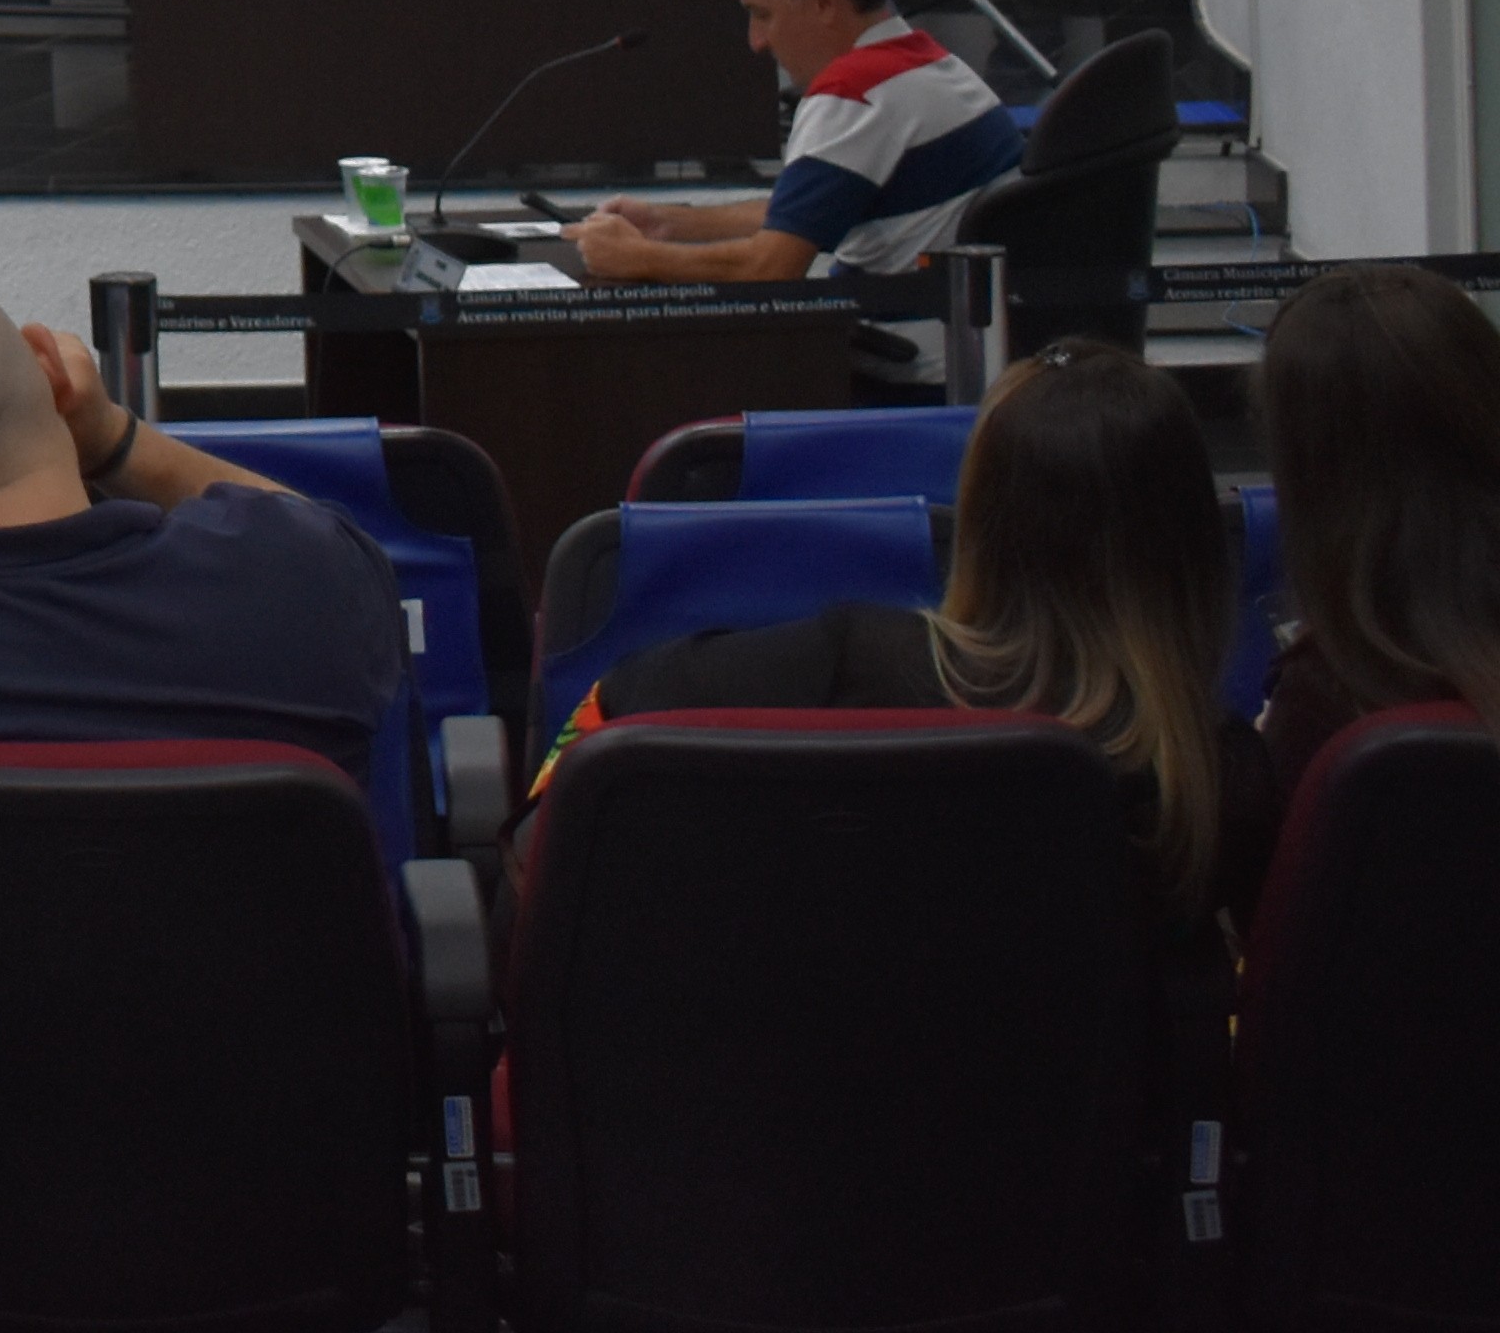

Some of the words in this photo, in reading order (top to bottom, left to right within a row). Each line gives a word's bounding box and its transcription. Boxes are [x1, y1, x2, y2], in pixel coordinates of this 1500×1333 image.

[1163, 268, 1220, 281] Câmara
[1223, 264, 1296, 280] Municipal
[456, 291, 513, 304] Câmara
[515, 289, 589, 305] Municipal
[592, 288, 612, 300] de
[614, 284, 717, 300] Cordeirópolis
[1165, 287, 1216, 300] Acesso
[1217, 285, 1275, 299] restrito
[457, 310, 510, 324] Acesso
[511, 308, 567, 321] restrito
[569, 309, 622, 323] apenas
[625, 307, 661, 321] para
[662, 301, 758, 318] funcionários
[760, 303, 769, 314] e
[160, 316, 215, 328] onários
